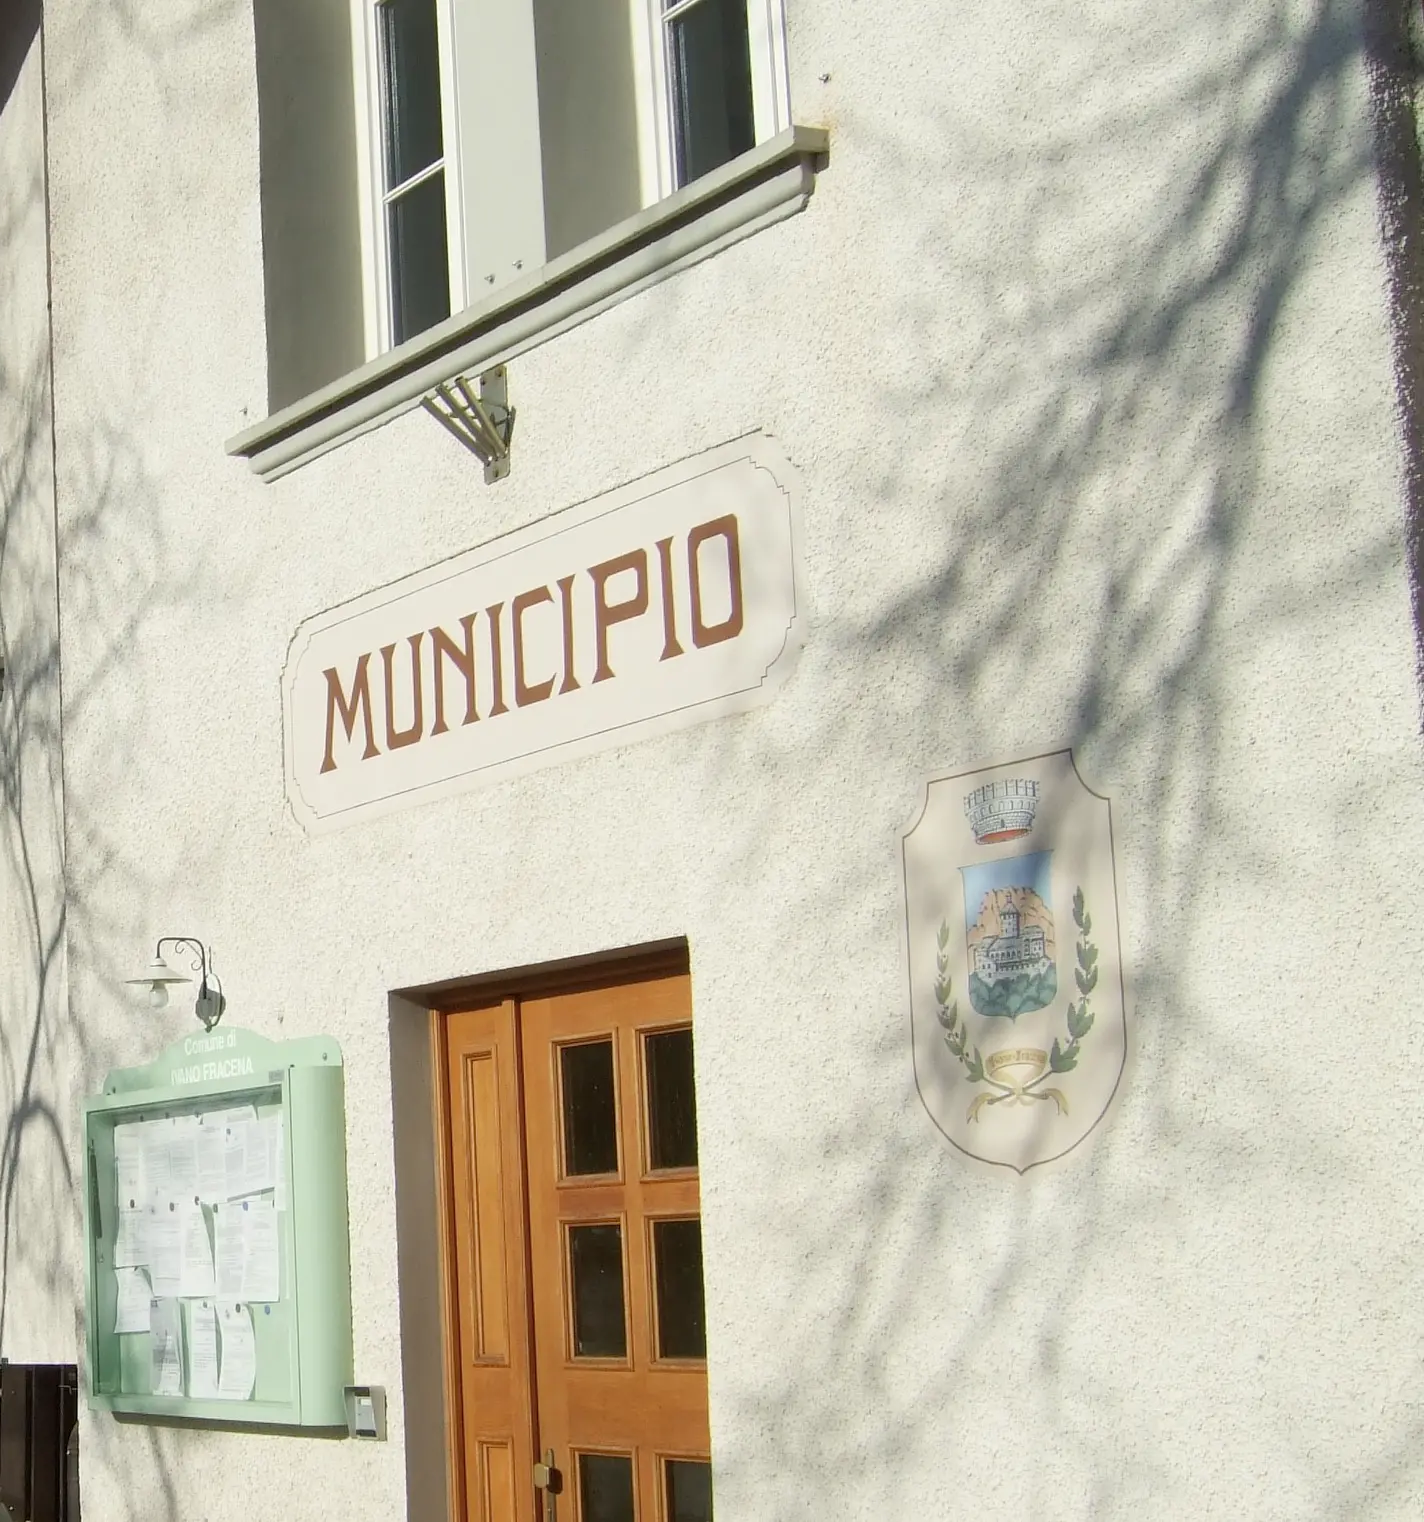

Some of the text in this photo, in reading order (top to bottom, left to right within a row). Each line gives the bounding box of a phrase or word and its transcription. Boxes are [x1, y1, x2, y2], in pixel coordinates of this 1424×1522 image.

[319, 513, 744, 775] MUNICIPIO
[184, 1029, 236, 1056] Comune di
[203, 1056, 254, 1081] FRACENA
